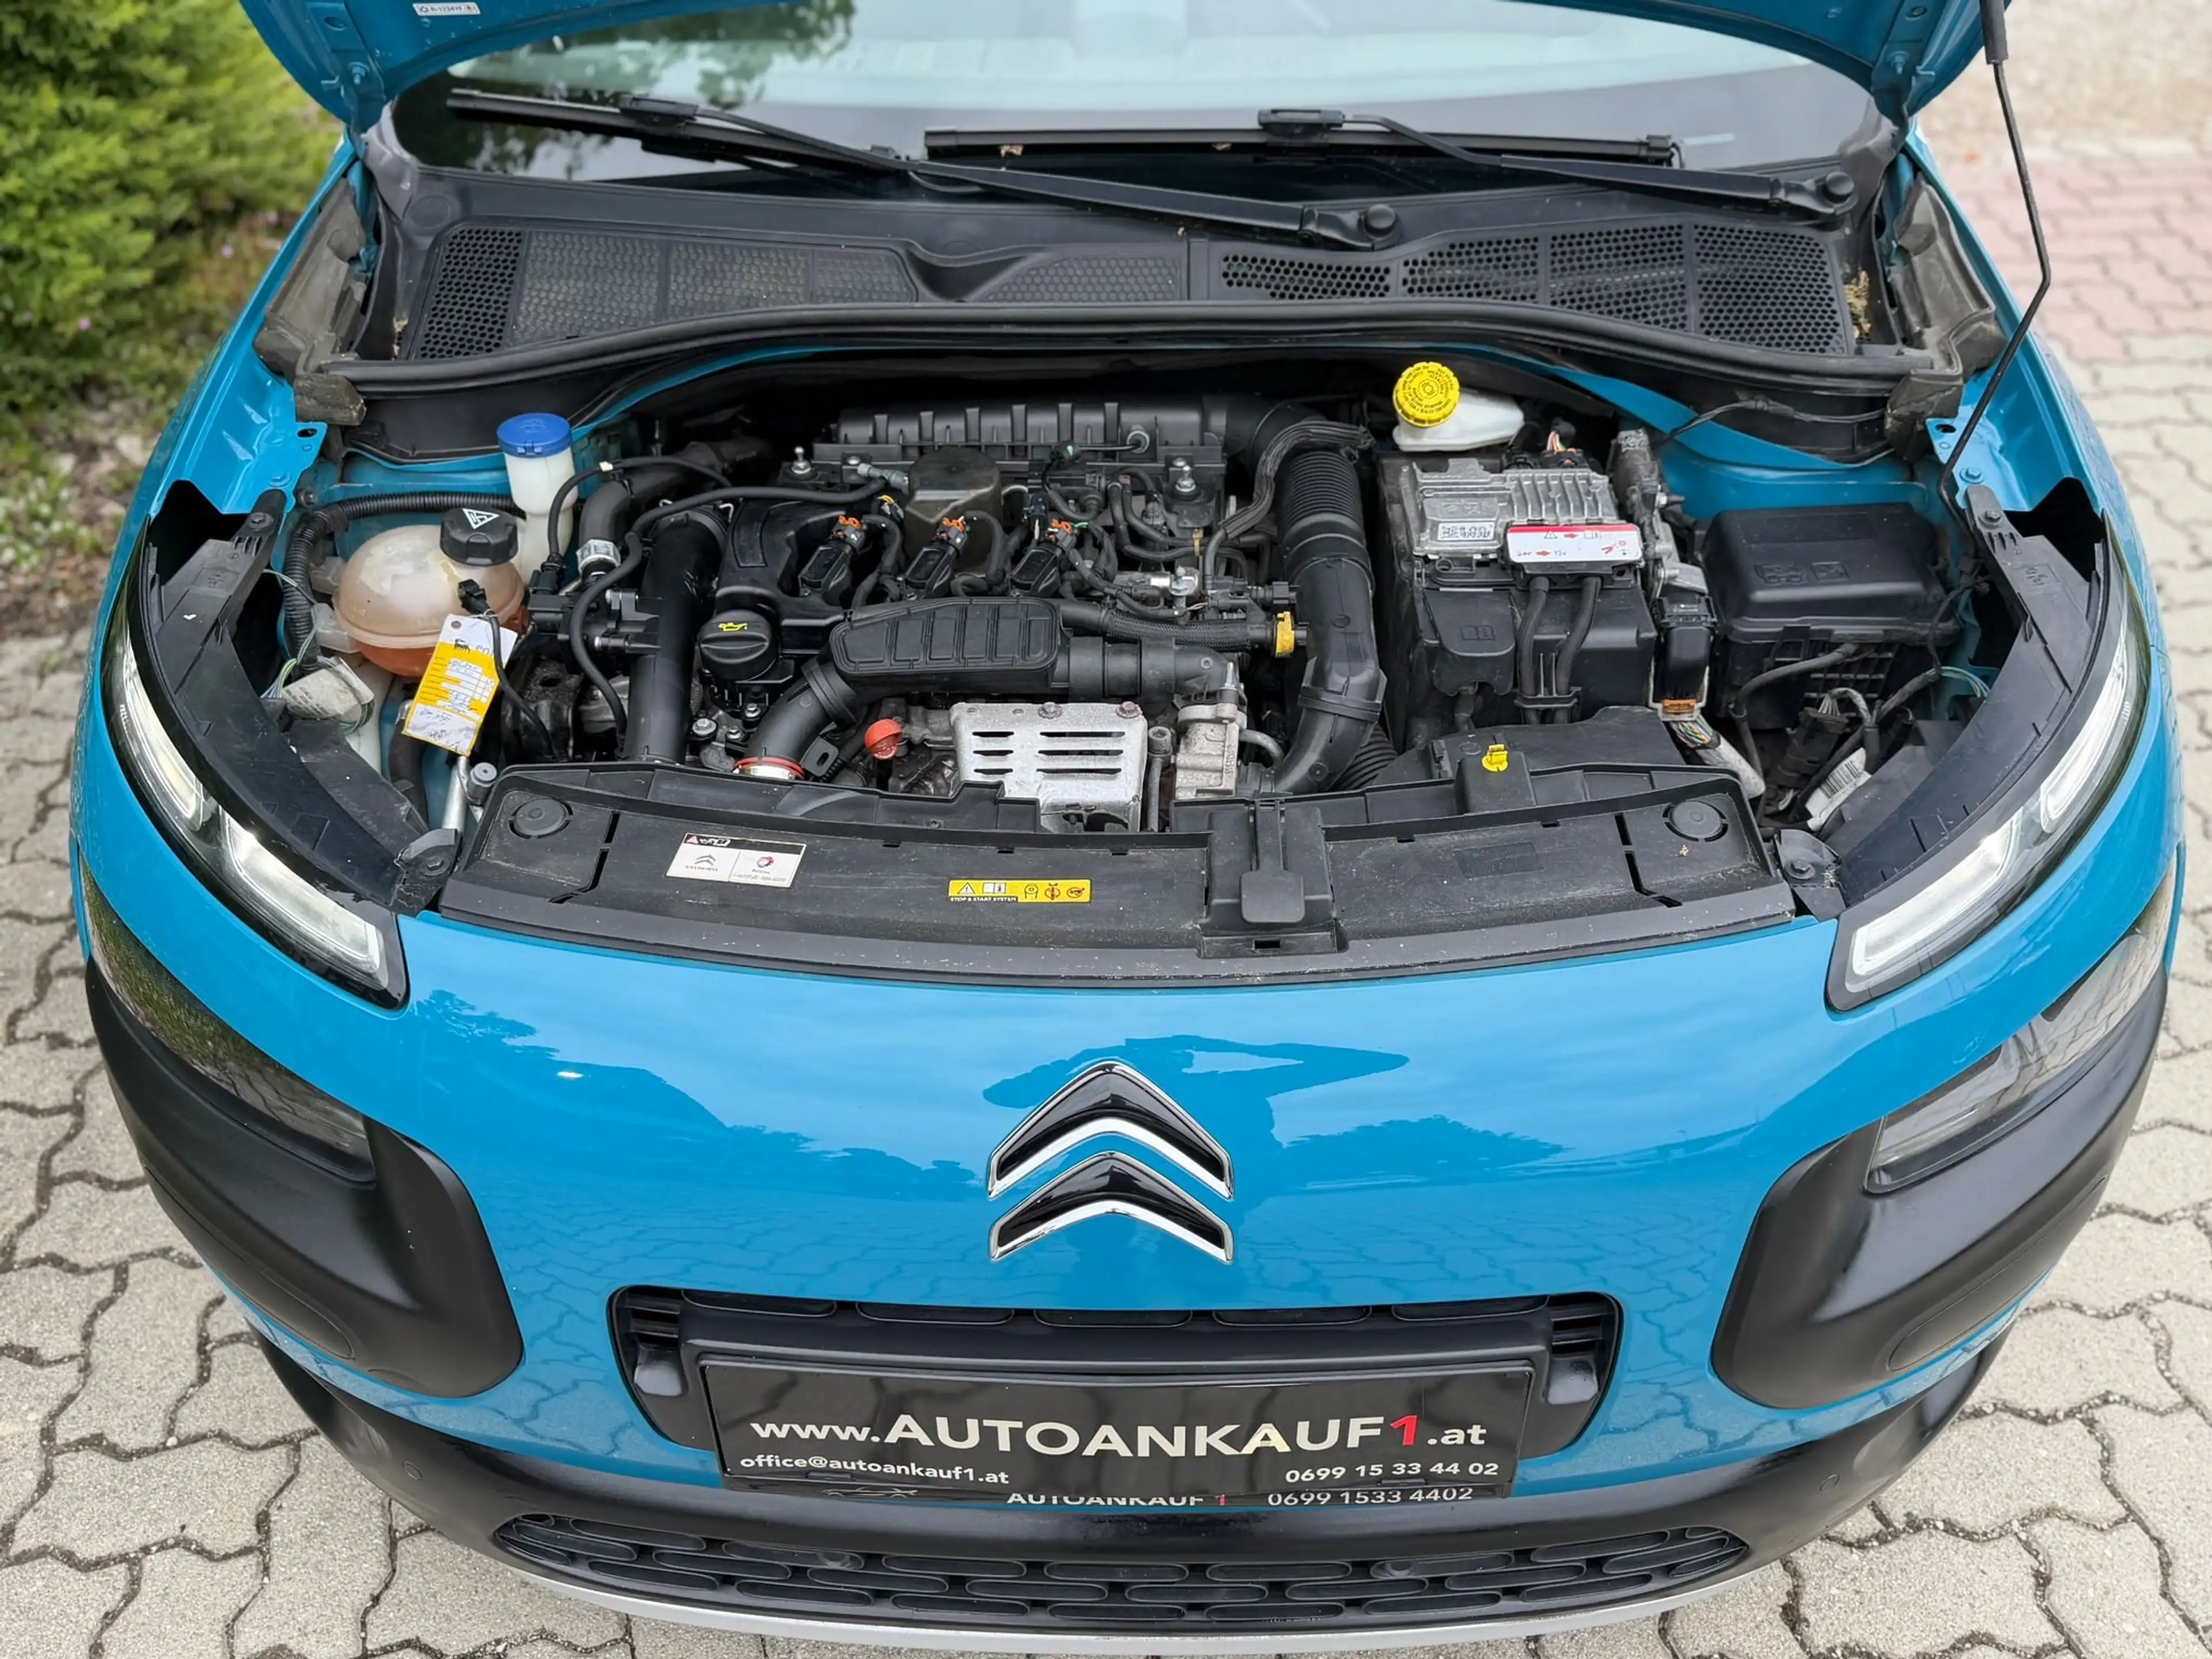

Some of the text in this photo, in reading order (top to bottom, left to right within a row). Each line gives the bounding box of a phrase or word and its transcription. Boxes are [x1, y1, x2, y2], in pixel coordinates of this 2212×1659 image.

[740, 1455, 1009, 1484] office@autoankauf1.at
[1285, 1462, 1499, 1483] 0699 15 33 44 02
[1268, 1490, 1331, 1506] 0699
[1340, 1489, 1402, 1505] 1533
[1409, 1487, 1474, 1502] 4402
